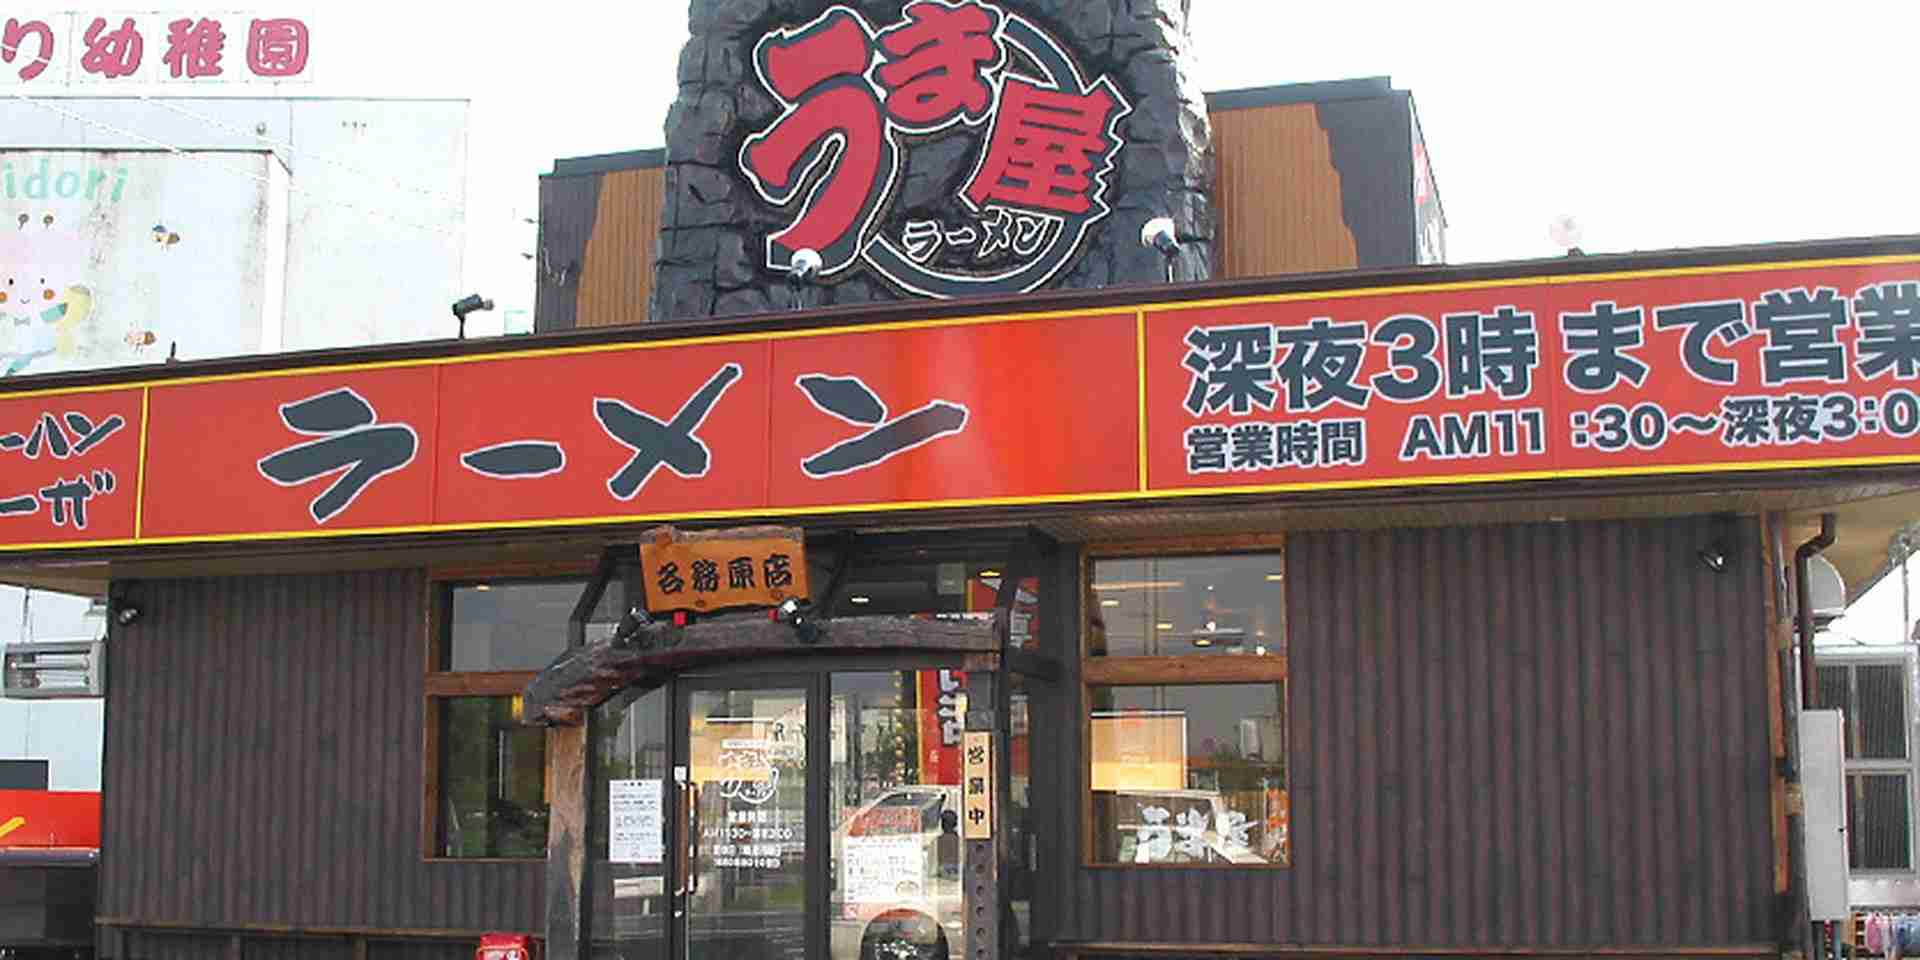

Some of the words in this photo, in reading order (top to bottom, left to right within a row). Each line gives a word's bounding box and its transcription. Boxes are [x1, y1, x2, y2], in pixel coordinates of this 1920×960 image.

[1, 17, 310, 82] り幼稚園
[741, 0, 1130, 273] うま屋
[902, 205, 1051, 263] ラーメン
[257, 362, 969, 524] ラーメン
[1186, 419, 1367, 473] 営業時間
